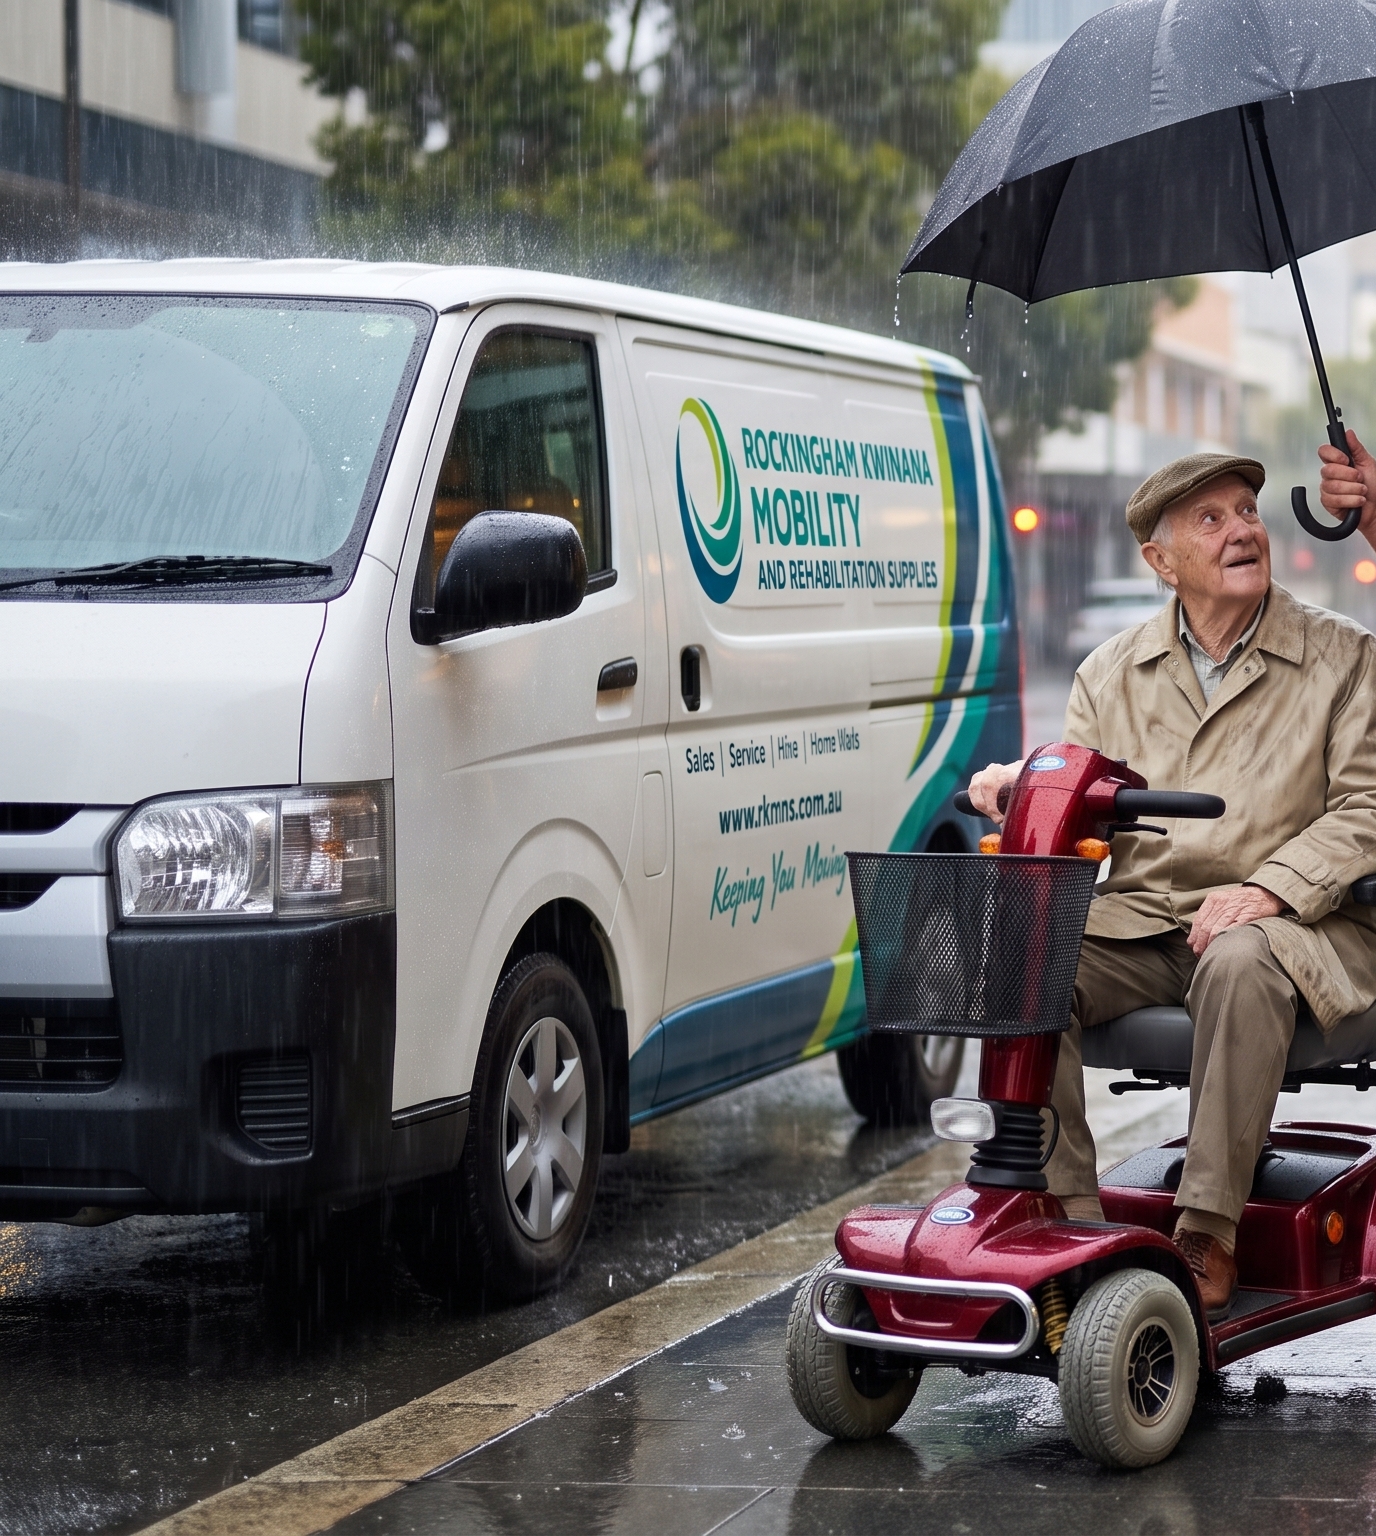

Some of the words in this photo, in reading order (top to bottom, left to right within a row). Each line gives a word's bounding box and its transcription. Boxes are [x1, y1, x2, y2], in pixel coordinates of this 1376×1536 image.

[741, 427, 859, 478] ROCKINGHAM
[860, 442, 934, 486] KWINANA
[751, 486, 862, 547] MOBILITY
[758, 560, 786, 590] AND
[789, 560, 886, 589] REHABILITATION
[888, 560, 938, 589] SUPPLIES
[686, 745, 715, 774] Sales
[729, 740, 766, 768] Service
[810, 732, 836, 755] Home
[719, 790, 842, 835] www.rkmns.com.au
[709, 866, 766, 928] Keeping
[771, 850, 796, 911] You
